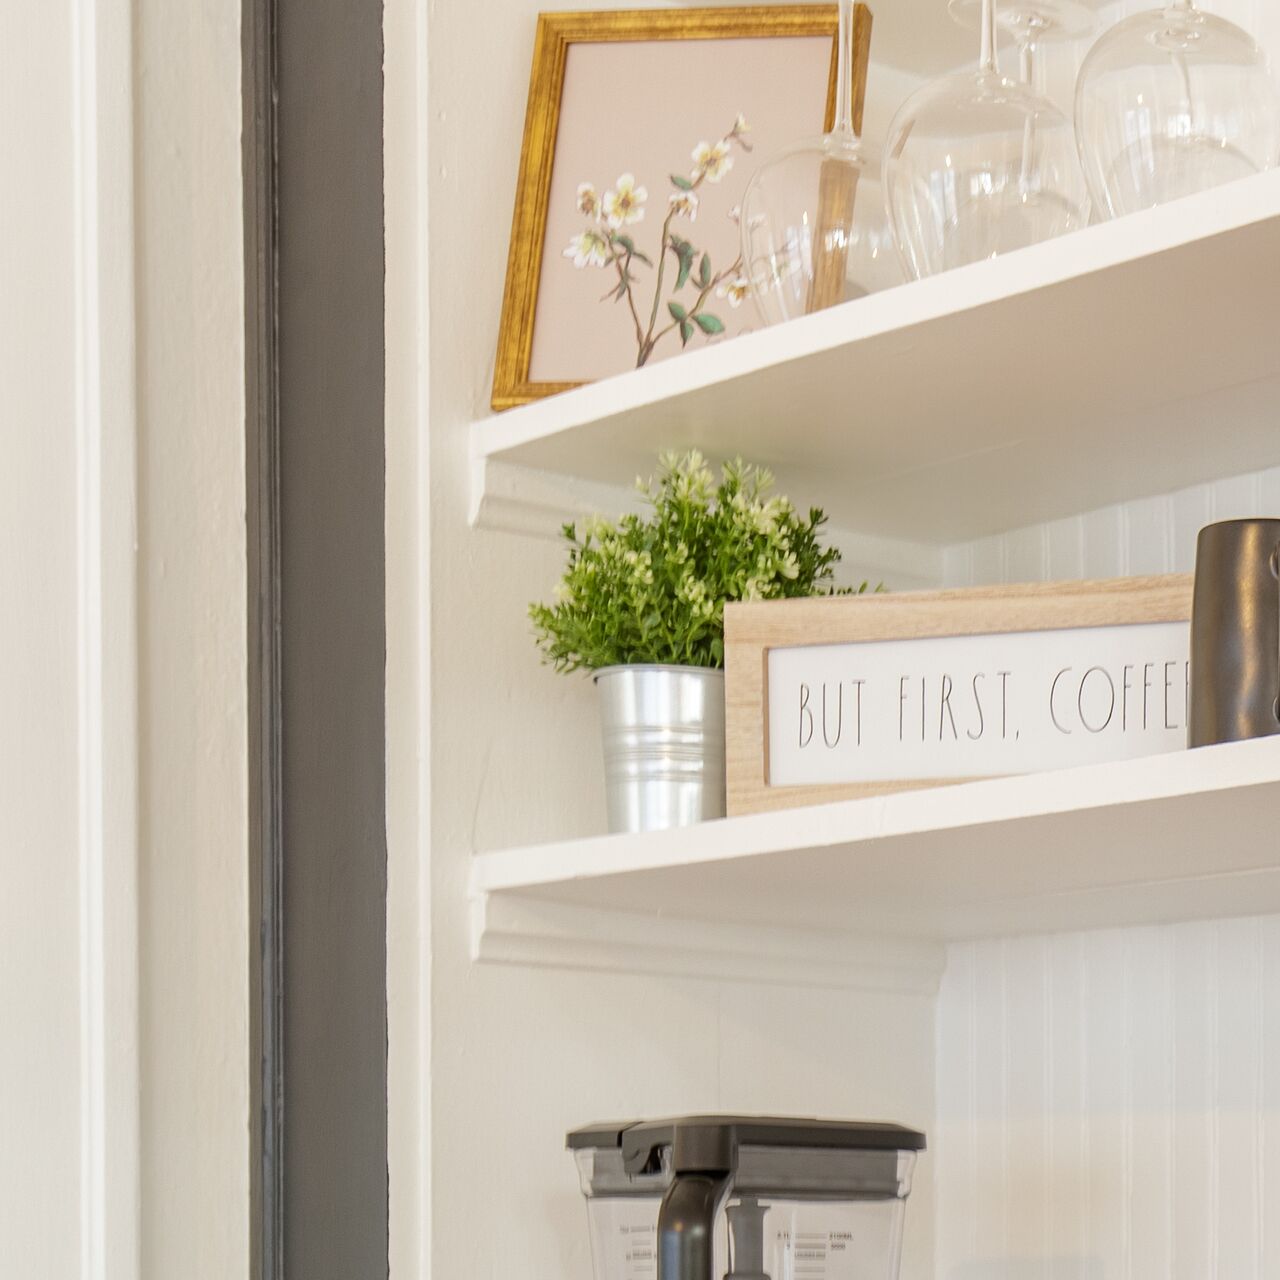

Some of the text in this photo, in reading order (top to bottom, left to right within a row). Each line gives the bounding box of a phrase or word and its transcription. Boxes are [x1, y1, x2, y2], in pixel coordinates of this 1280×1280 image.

[799, 660, 1190, 749] BUT FIRST, COFFE
